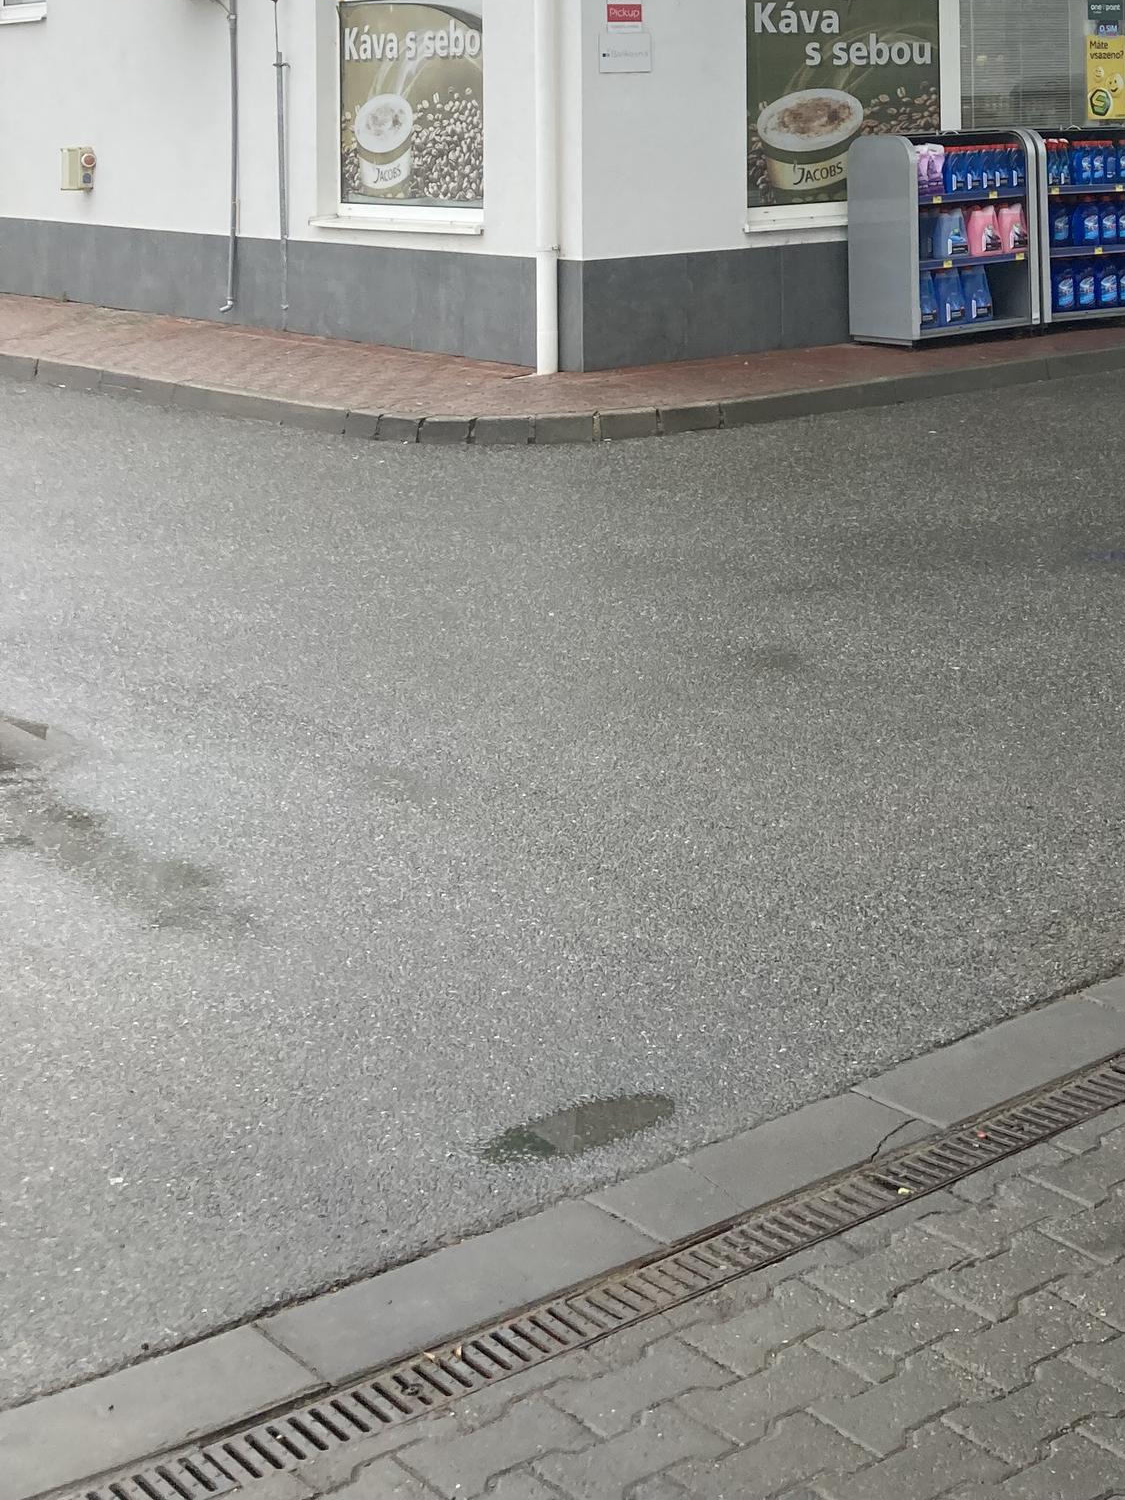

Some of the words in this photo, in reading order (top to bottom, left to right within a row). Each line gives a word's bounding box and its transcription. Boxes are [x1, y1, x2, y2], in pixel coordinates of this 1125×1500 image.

[609, 7, 640, 18] Pickup
[753, 1, 840, 35] Káva
[344, 24, 399, 61] Káva
[405, 30, 418, 59] s
[805, 41, 822, 66] s
[832, 33, 932, 66] sebou
[373, 166, 402, 184] JACOBS
[792, 161, 844, 186] JACOBS
